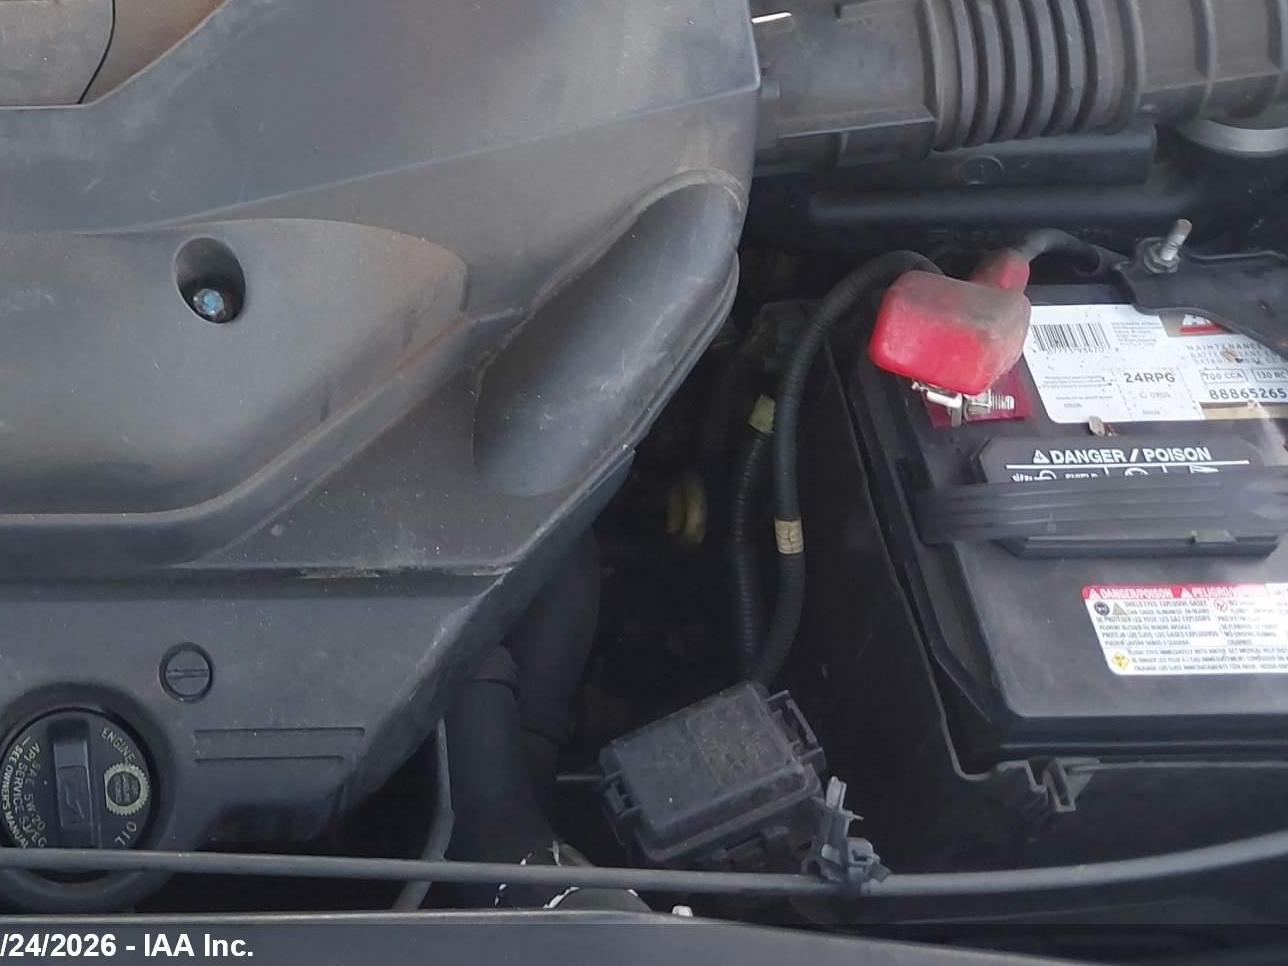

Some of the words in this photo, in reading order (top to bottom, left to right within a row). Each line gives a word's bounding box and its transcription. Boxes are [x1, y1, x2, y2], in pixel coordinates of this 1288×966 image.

[1123, 371, 1176, 384] 24RPG
[1201, 371, 1222, 380] 700
[1224, 370, 1244, 380] CCA
[1208, 387, 1288, 401] 88865265
[1049, 449, 1127, 464] DANGER
[1129, 448, 1139, 463] /
[1142, 446, 1212, 462] POISON
[8, 745, 24, 764] SEE
[24, 742, 41, 762] API
[101, 727, 136, 764] ENGINE
[25, 761, 41, 786] SAE
[13, 762, 29, 814] SERVICE
[4, 811, 29, 849] MANUAL
[114, 821, 138, 846] OIL
